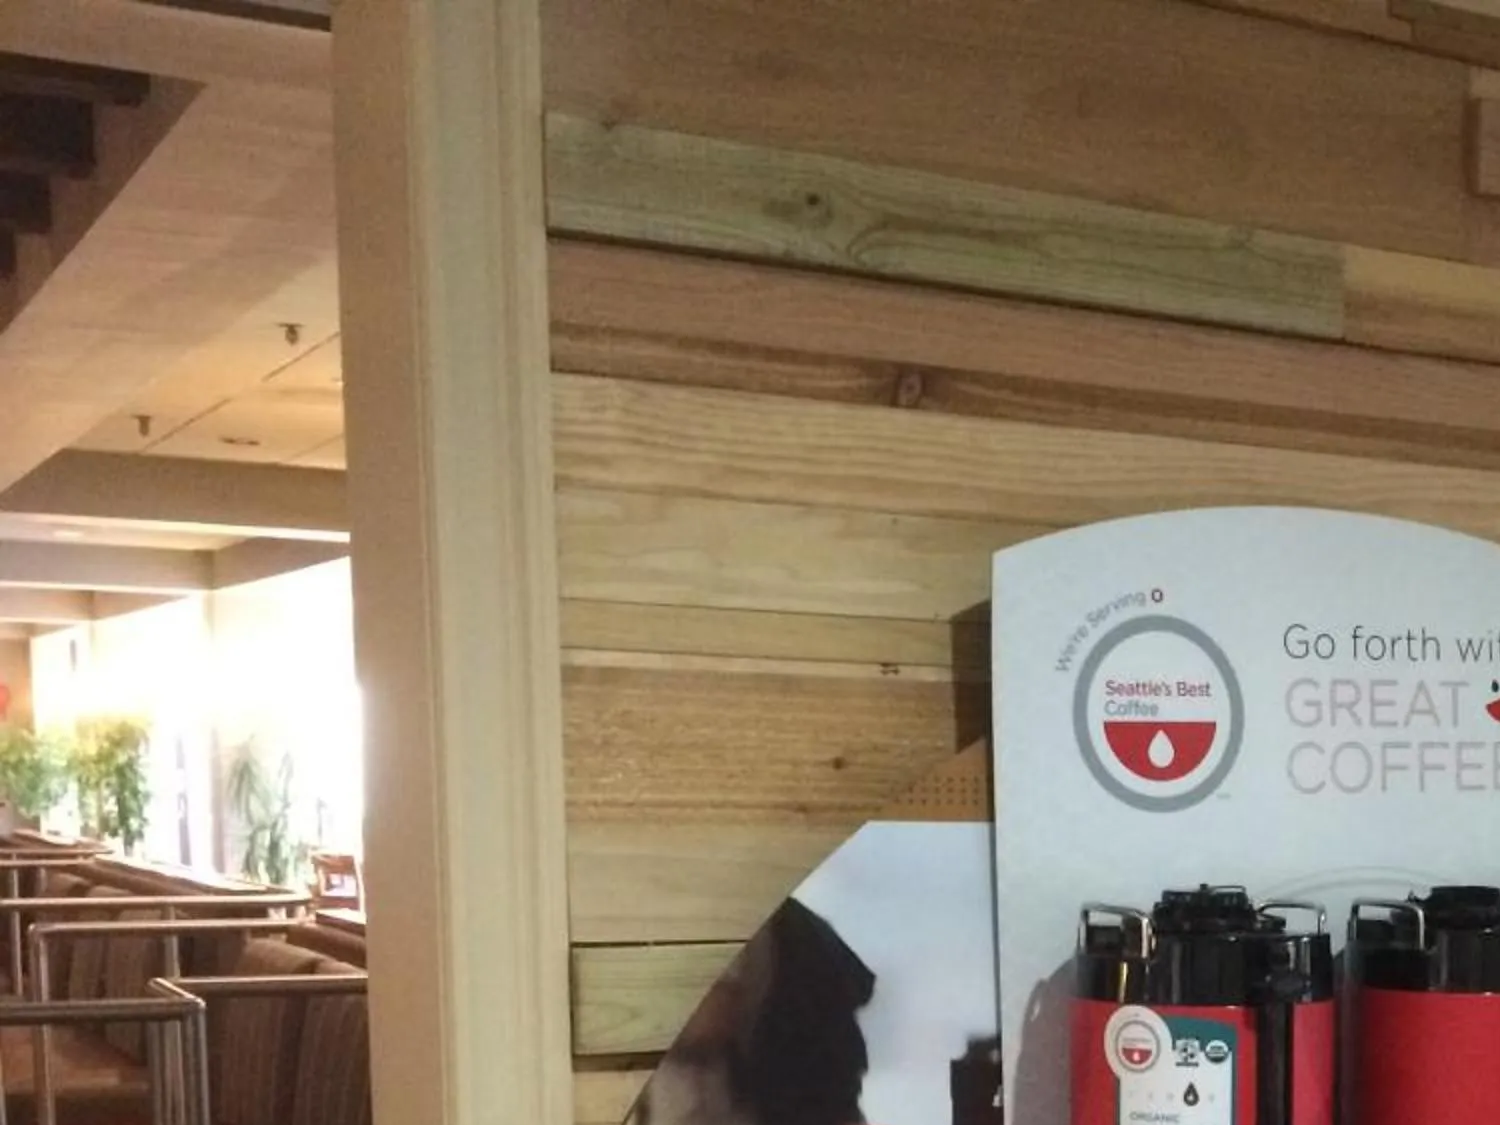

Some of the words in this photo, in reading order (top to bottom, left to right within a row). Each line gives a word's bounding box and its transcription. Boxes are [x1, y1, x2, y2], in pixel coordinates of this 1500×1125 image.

[1086, 590, 1148, 630] Serving
[1283, 623, 1337, 661] Go
[1351, 624, 1442, 663] forth
[1104, 679, 1172, 698] Seattle's
[1176, 680, 1213, 698] Best
[1284, 676, 1471, 729] GREAT
[1103, 699, 1160, 717] Coffee
[1128, 1110, 1180, 1124] ORGANIC
